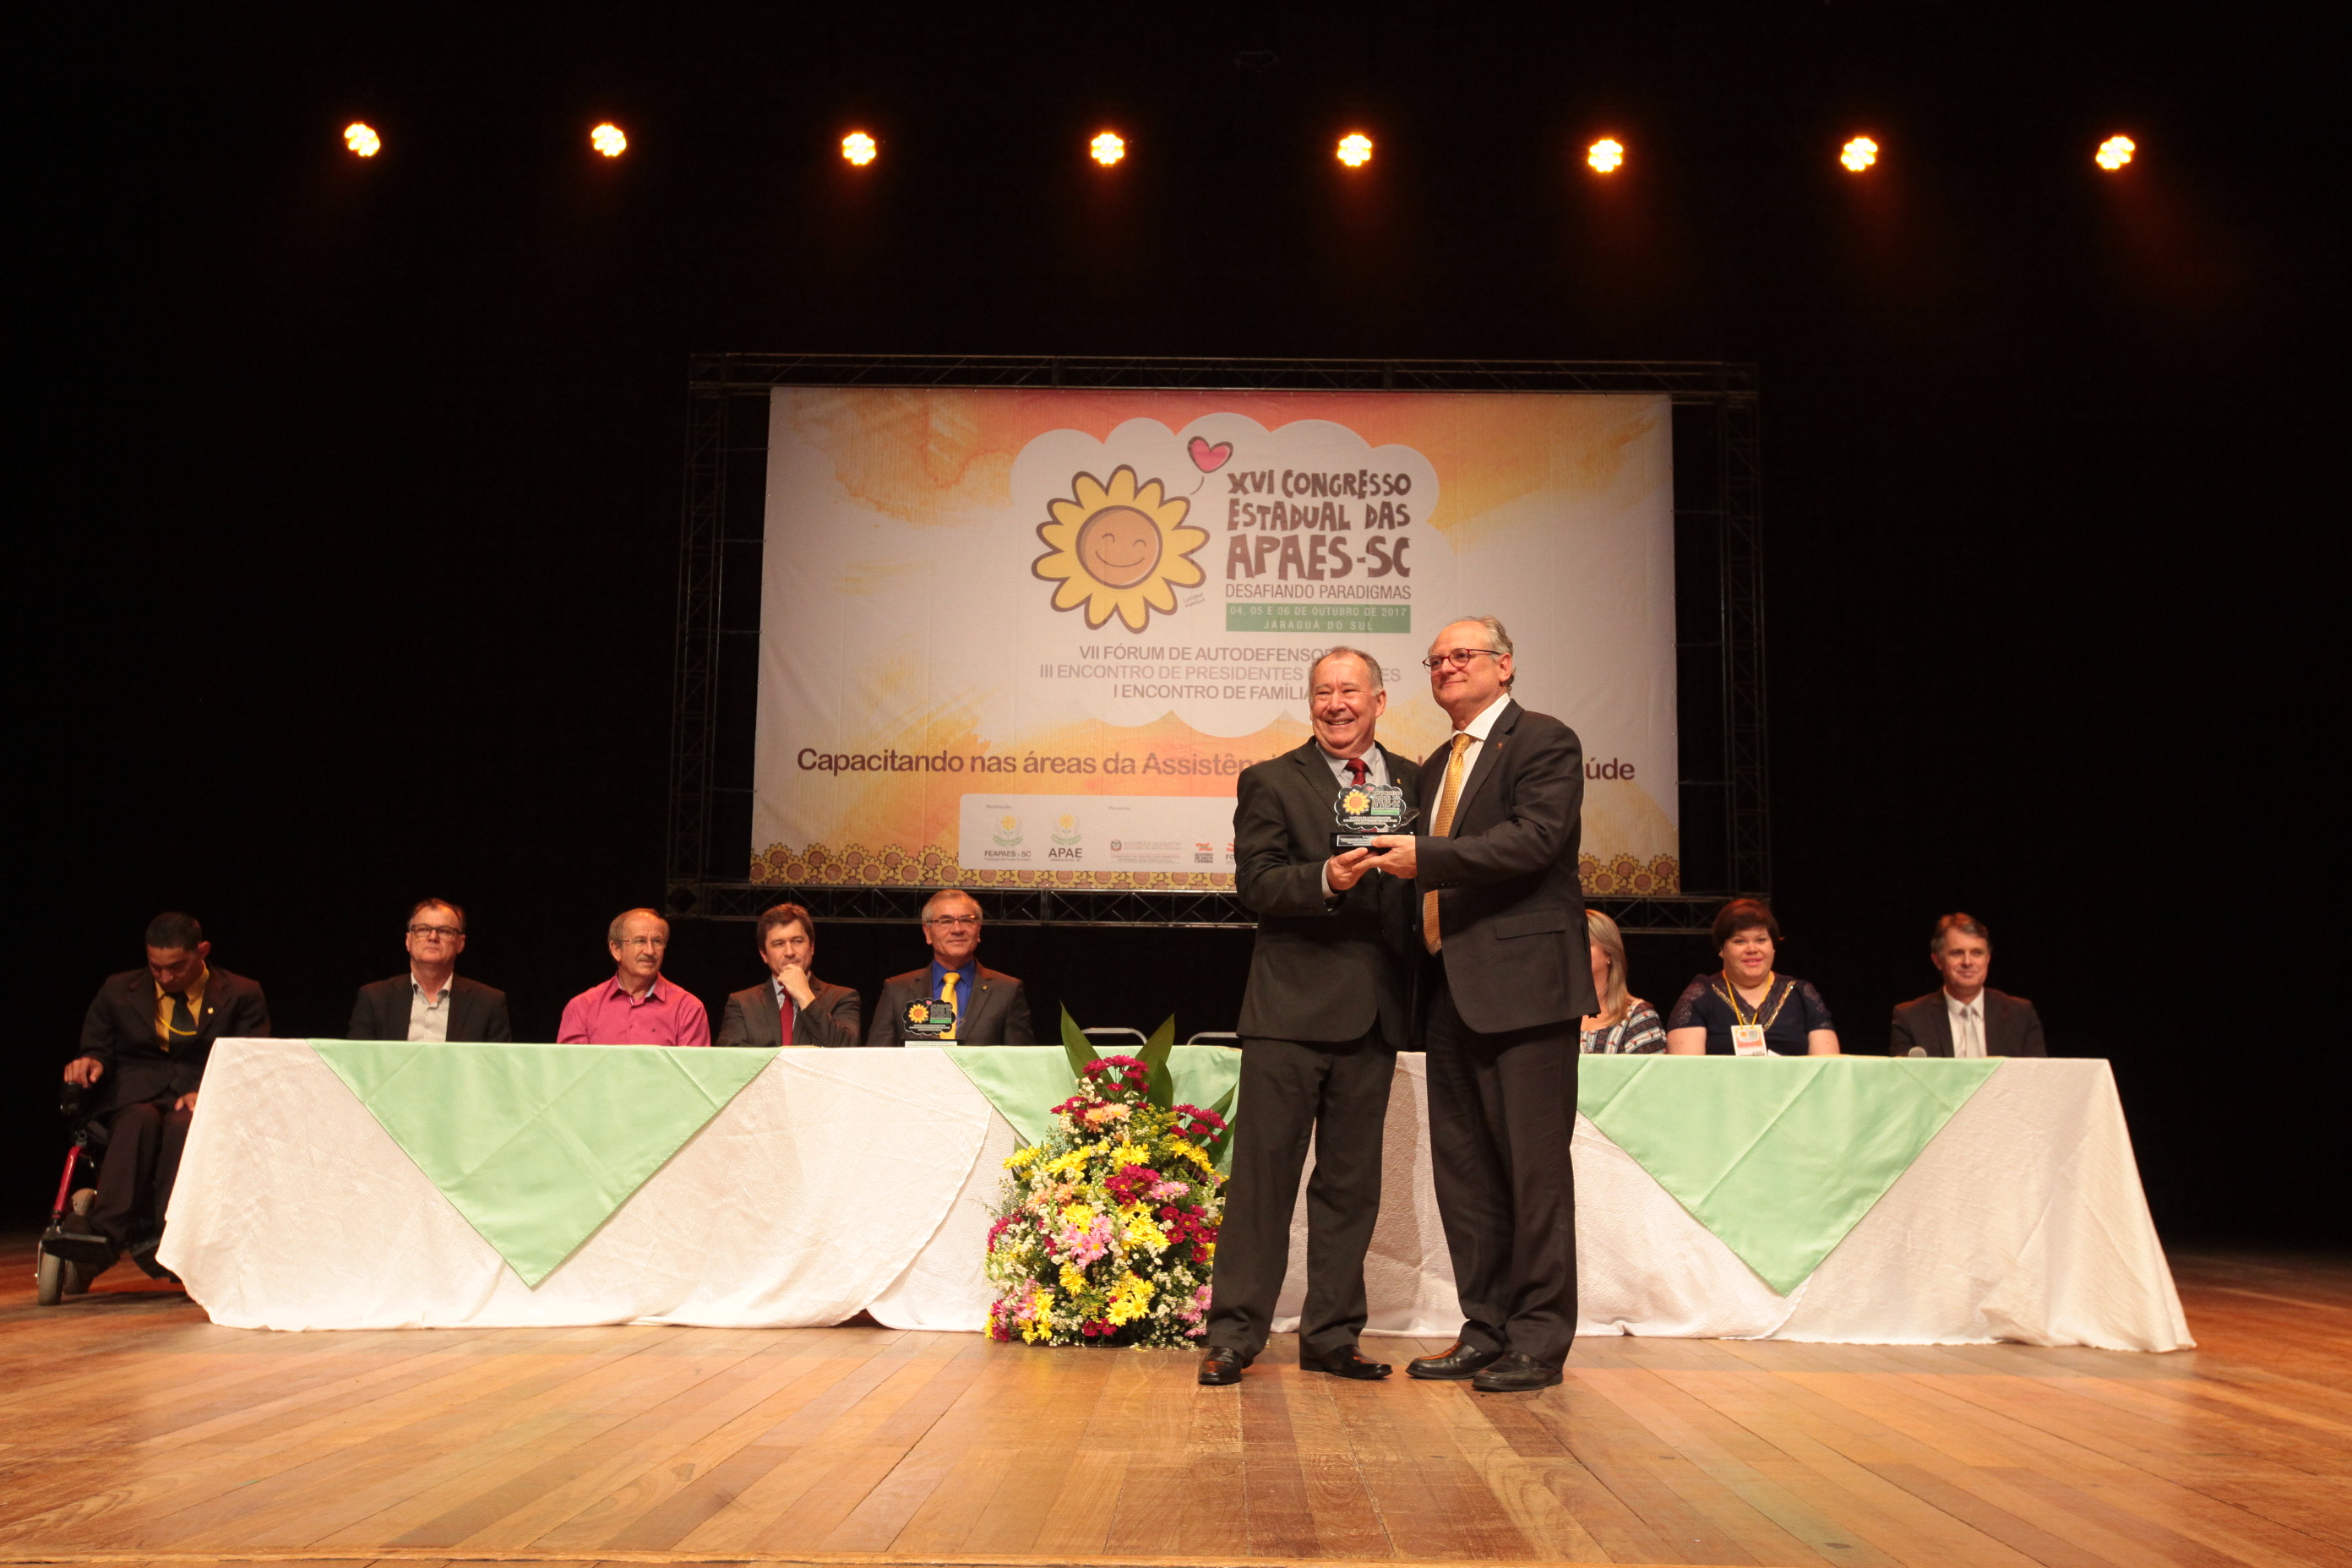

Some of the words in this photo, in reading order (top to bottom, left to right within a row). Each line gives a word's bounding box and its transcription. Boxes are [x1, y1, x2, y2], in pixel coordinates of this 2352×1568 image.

[1227, 469, 1275, 496] XVI
[1281, 469, 1412, 500] CONGRESSO
[1227, 498, 1352, 532] ESTADUAL
[1364, 500, 1411, 531] DAS
[1226, 533, 1412, 581] APAES-SC
[1225, 584, 1315, 599] DESAFIANDO
[1320, 585, 1412, 600] PARADIGMAS
[1250, 606, 1264, 616] 05
[1267, 607, 1273, 616] E
[1277, 607, 1290, 616] 06
[1294, 607, 1308, 617] DE
[1311, 607, 1359, 617] OUTUBRO
[1364, 607, 1378, 618] DE
[1381, 607, 1407, 618] 2017
[1264, 618, 1320, 630] JARAGUÁ
[1327, 620, 1344, 630] DO
[1350, 621, 1374, 631] SUL
[1079, 645, 1100, 660] VII
[1103, 642, 1165, 660] FÓRUM
[1168, 646, 1192, 661] DE
[1039, 664, 1054, 678] III
[1057, 664, 1155, 679] ENCONTRO
[1158, 665, 1182, 680] DE
[1185, 666, 1304, 681] PRESIDENTES
[1113, 684, 1118, 698] I
[1121, 684, 1220, 700] ENCONTRO
[1224, 685, 1247, 700] DE
[797, 748, 965, 777] Capacitando
[971, 755, 1017, 773] nas
[1023, 751, 1097, 774] áreas
[1102, 751, 1135, 775] da
[1585, 757, 1636, 781] úde
[1048, 847, 1083, 858] APAE
